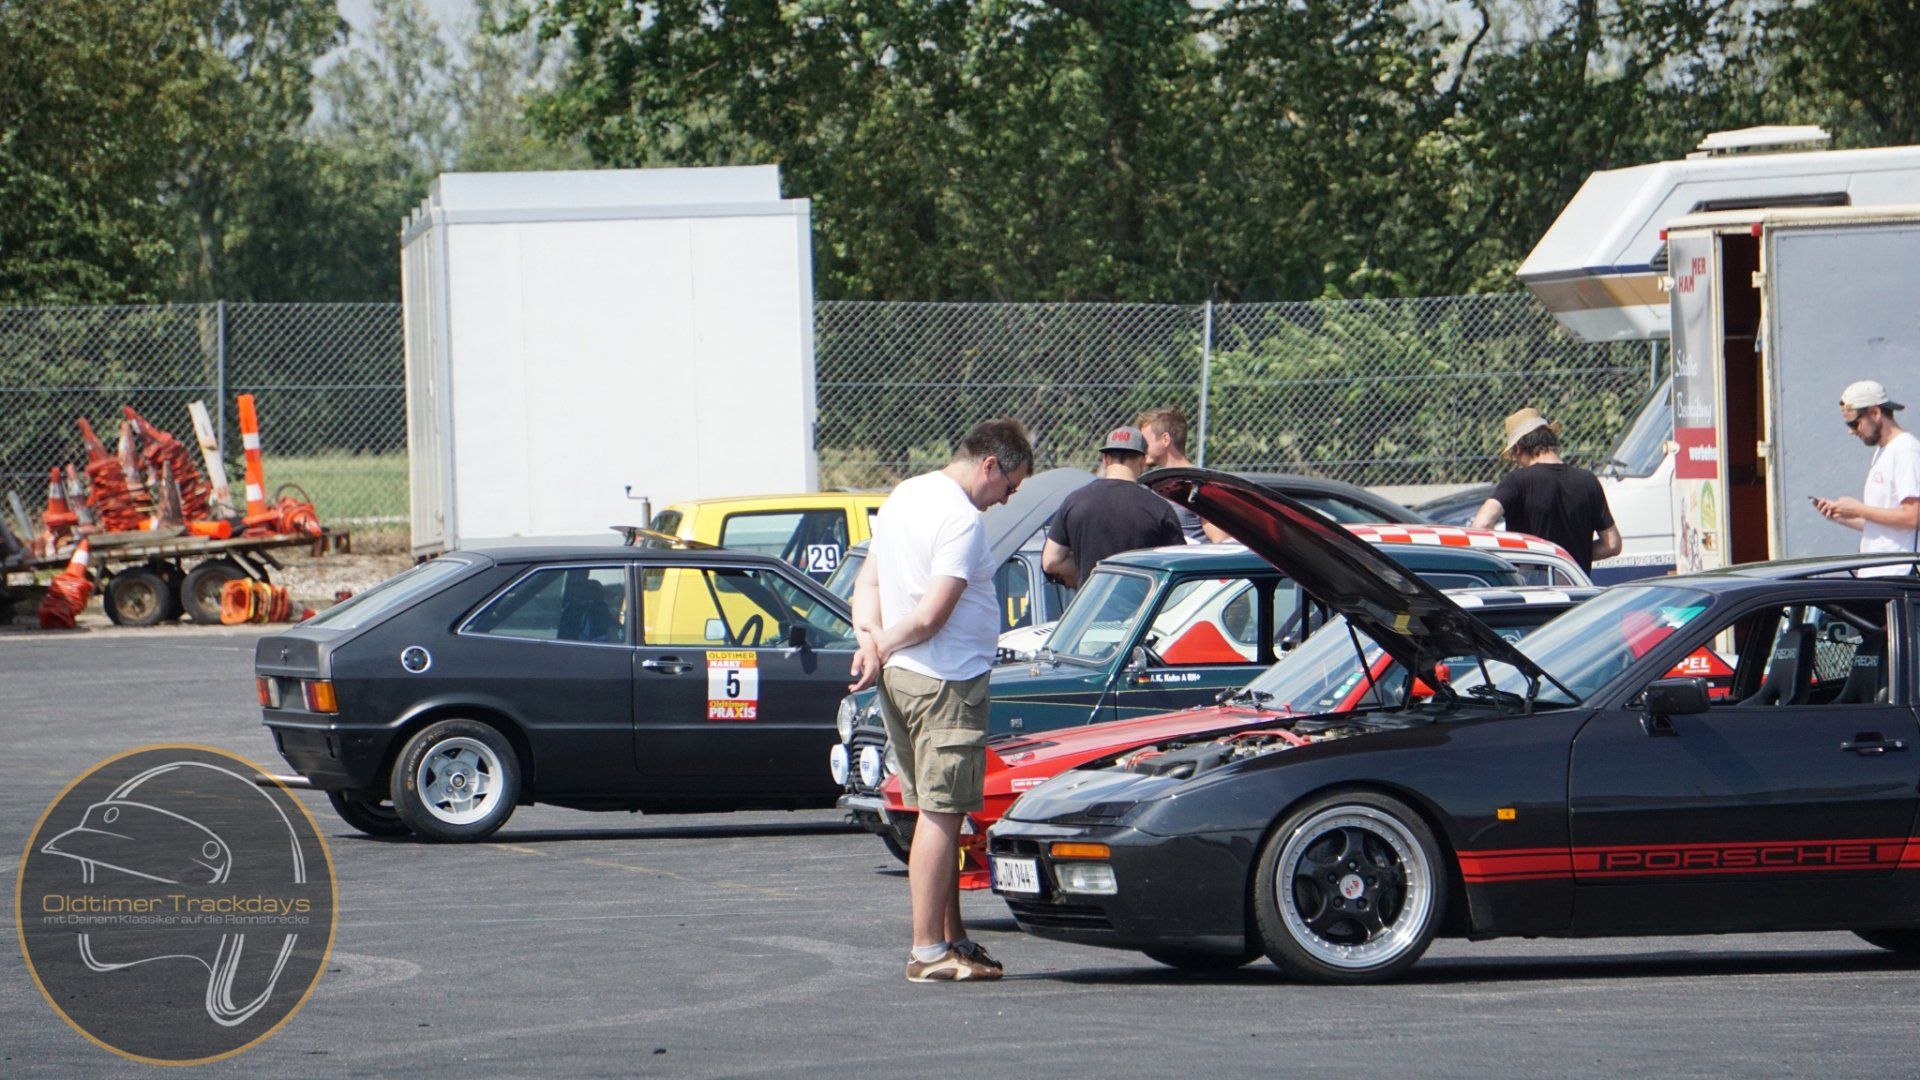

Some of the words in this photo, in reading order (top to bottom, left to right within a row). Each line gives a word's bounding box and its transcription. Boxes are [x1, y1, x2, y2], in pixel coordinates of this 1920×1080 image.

[811, 546, 838, 570] 29
[708, 652, 755, 660] OLDTIMER
[1677, 657, 1710, 669] PEL
[726, 669, 740, 698] 5
[709, 700, 749, 708] Oldtimer
[709, 706, 757, 719] PRAXIS
[1606, 846, 1870, 870] PORSCHE
